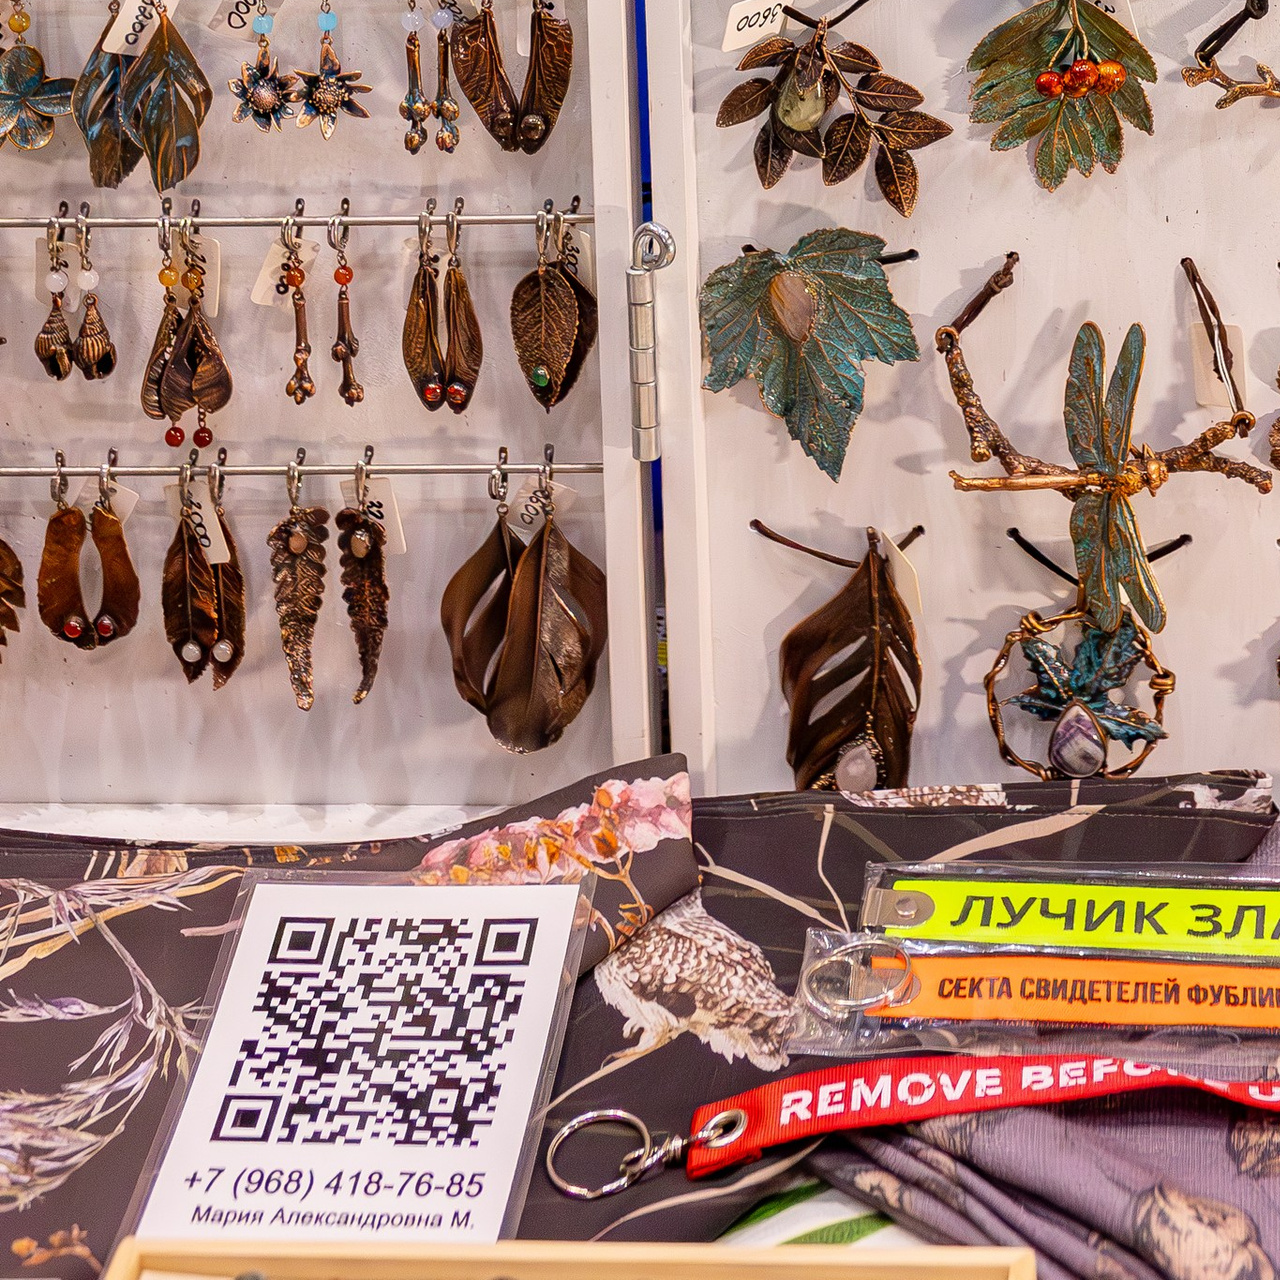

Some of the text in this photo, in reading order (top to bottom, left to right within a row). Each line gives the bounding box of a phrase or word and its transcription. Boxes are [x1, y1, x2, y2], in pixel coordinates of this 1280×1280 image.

[736, 3, 783, 32] 3600
[950, 895, 1171, 935] ЛУЧИК
[938, 977, 1013, 1001] СЕКТА
[1020, 976, 1181, 1005] СВИДЕТЕЛЕЙ
[779, 1067, 1003, 1126] REMOVE
[184, 1167, 486, 1201] +7 (968) 418-76-85
[190, 1205, 263, 1228] Мария
[270, 1206, 443, 1230] Александровна
